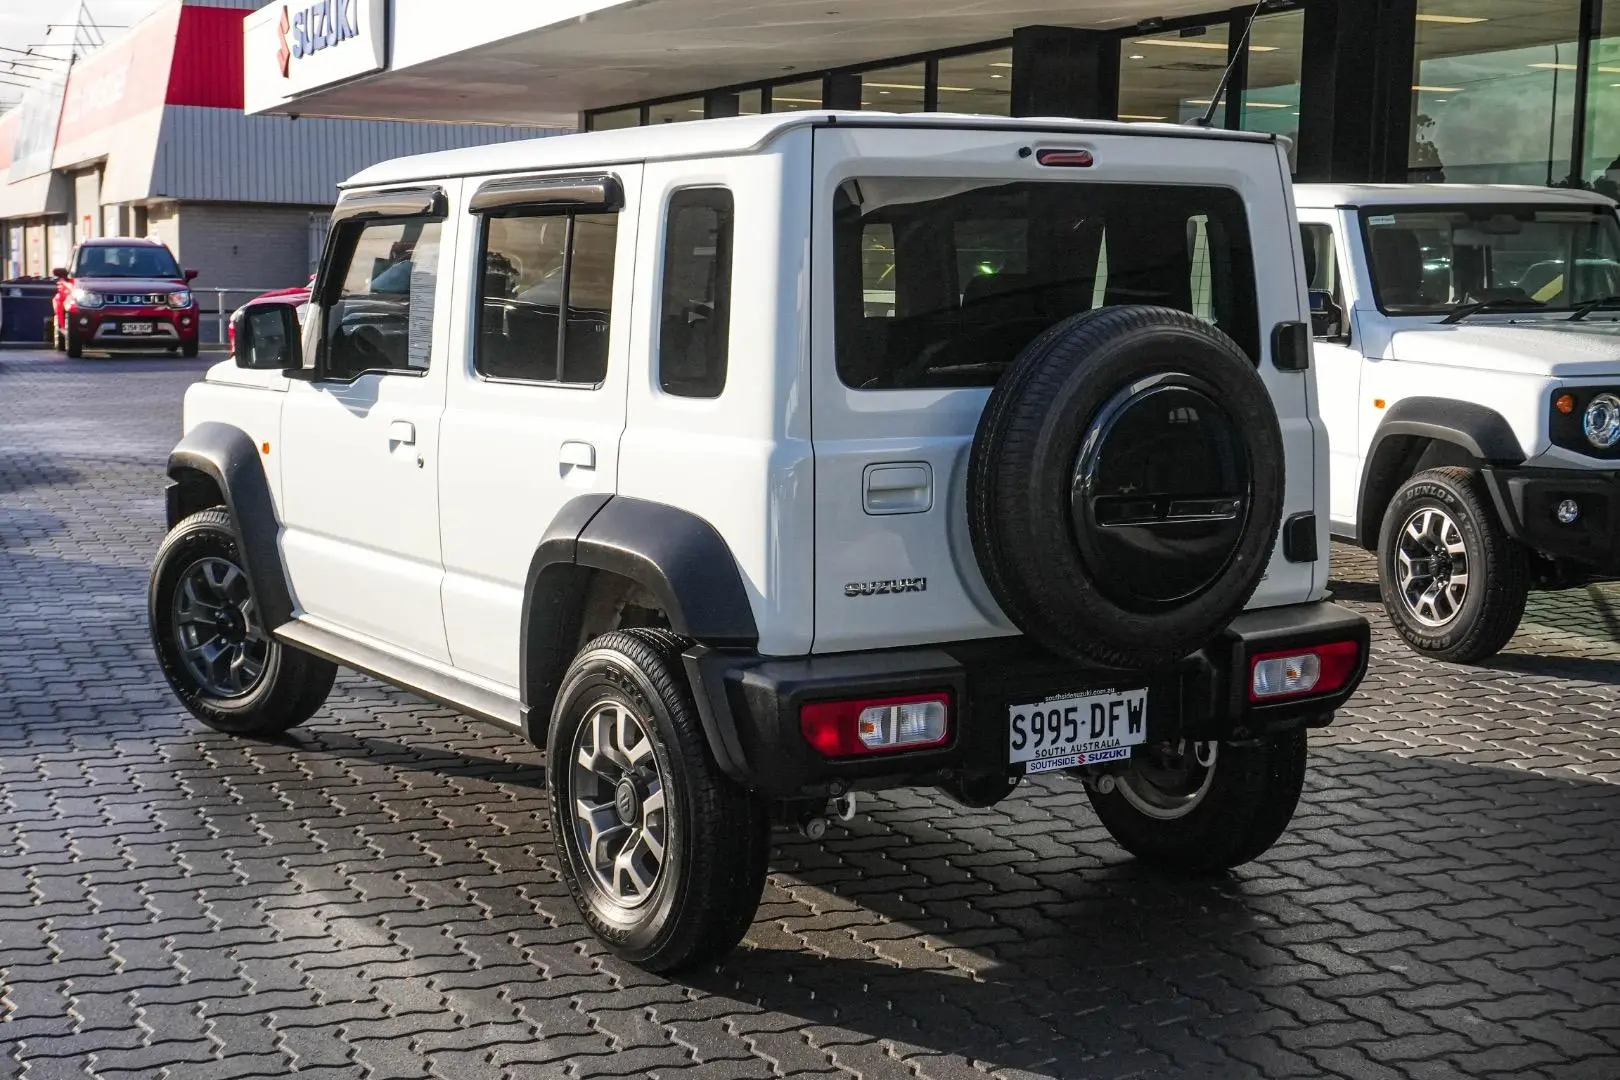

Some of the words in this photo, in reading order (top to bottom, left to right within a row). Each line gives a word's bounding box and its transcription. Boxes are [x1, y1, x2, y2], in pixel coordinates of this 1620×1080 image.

[292, 0, 359, 59] SUZUKI
[1406, 485, 1455, 504] DUNLOP
[844, 577, 927, 597] SUZUKI
[1035, 747, 1066, 758] SOUTH
[1070, 738, 1121, 753] AUSTRALIA
[1030, 756, 1075, 771] SOUTHSIDE
[1088, 748, 1127, 762] SUZUKI
